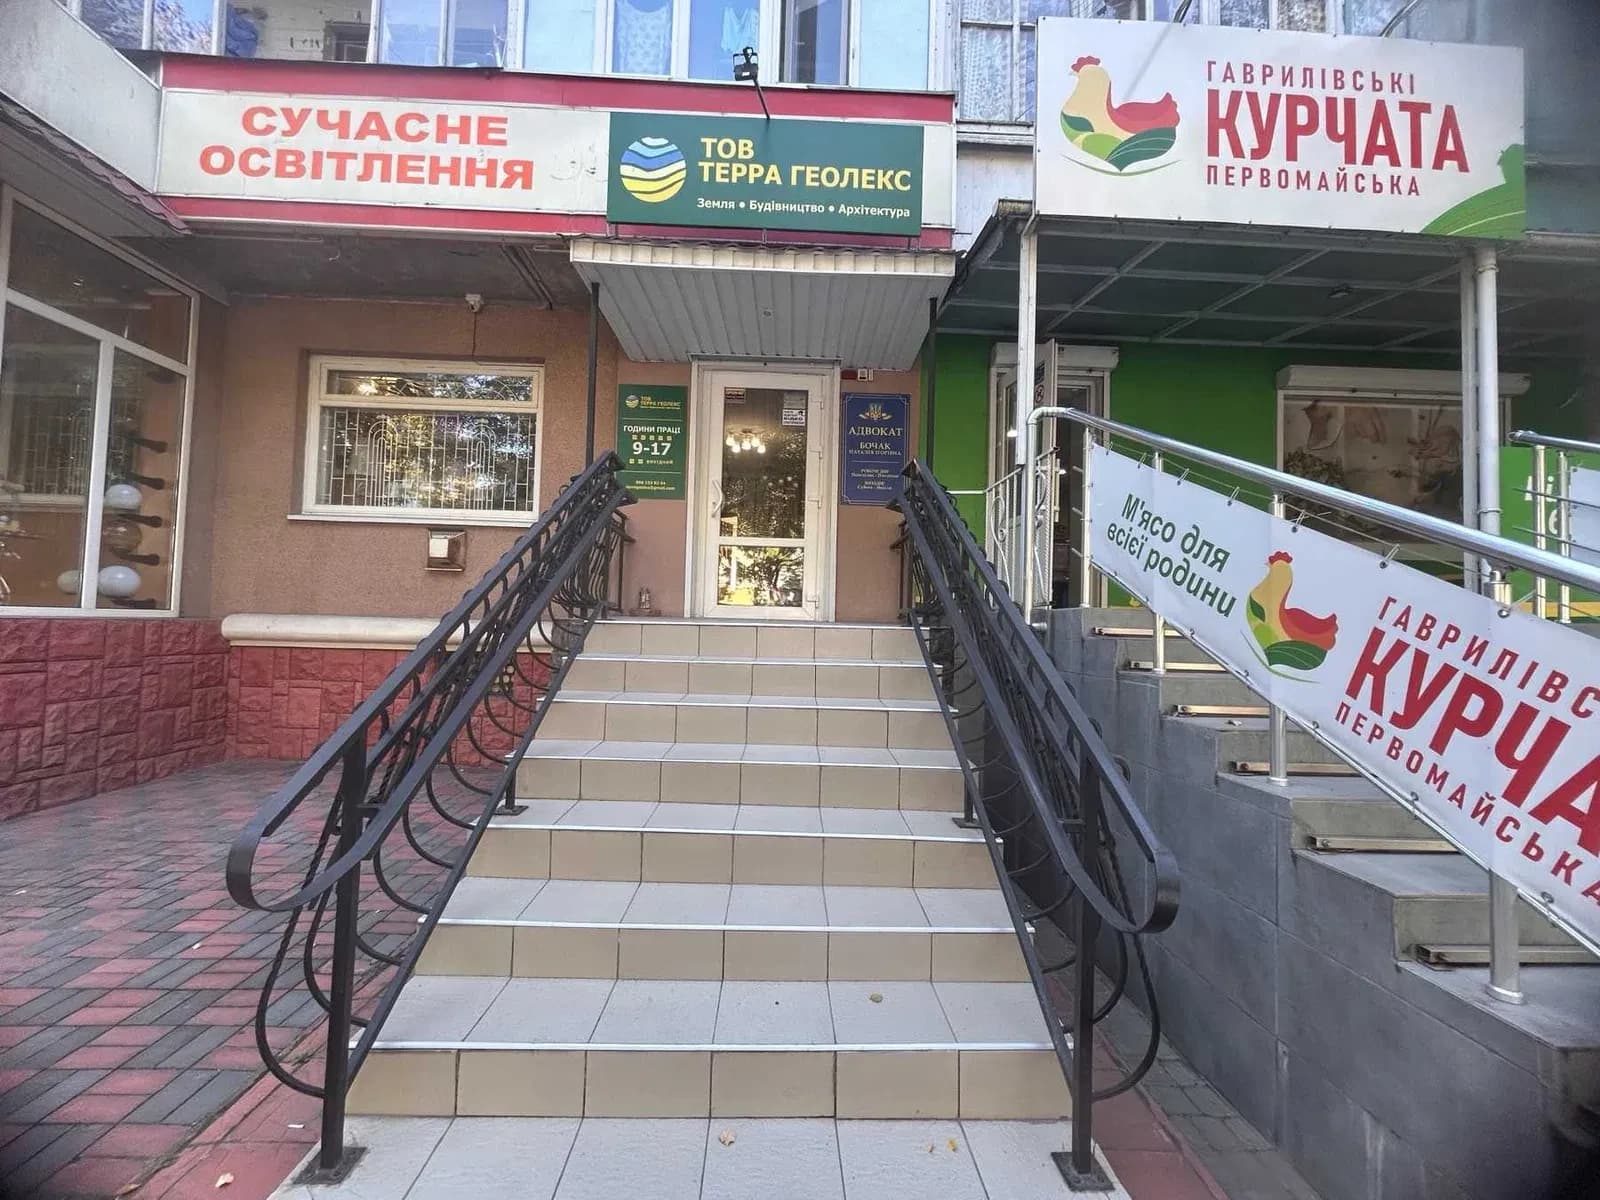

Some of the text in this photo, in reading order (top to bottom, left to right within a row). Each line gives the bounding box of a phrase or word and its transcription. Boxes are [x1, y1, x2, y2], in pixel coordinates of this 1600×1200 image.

[1207, 60, 1416, 94] ГАВРИЛІВСЬКІ
[241, 106, 509, 147] СУЧАСНЕ
[1207, 88, 1470, 173] КУРЧАТА
[701, 137, 755, 159] ТОВ
[199, 146, 533, 190] ОСВІТЛЕННЯ
[698, 161, 911, 191] ТЕРРА ГЕОЛЕКС
[1206, 165, 1421, 196] ПЕРВОМАЙСЬКА
[697, 198, 910, 218] Земля Будівництво Архітектура
[623, 425, 681, 434] ГОДИНИ ПРАЦІ
[848, 426, 903, 436] АДВОКАТ
[859, 441, 891, 450] БОЧАК
[632, 441, 671, 455] 9-17
[1121, 493, 1231, 573] М'ясо для
[1106, 521, 1238, 618] всієї родини
[1378, 596, 1600, 719] ГАВРИЛІВС
[1345, 627, 1600, 859] КУРЧА
